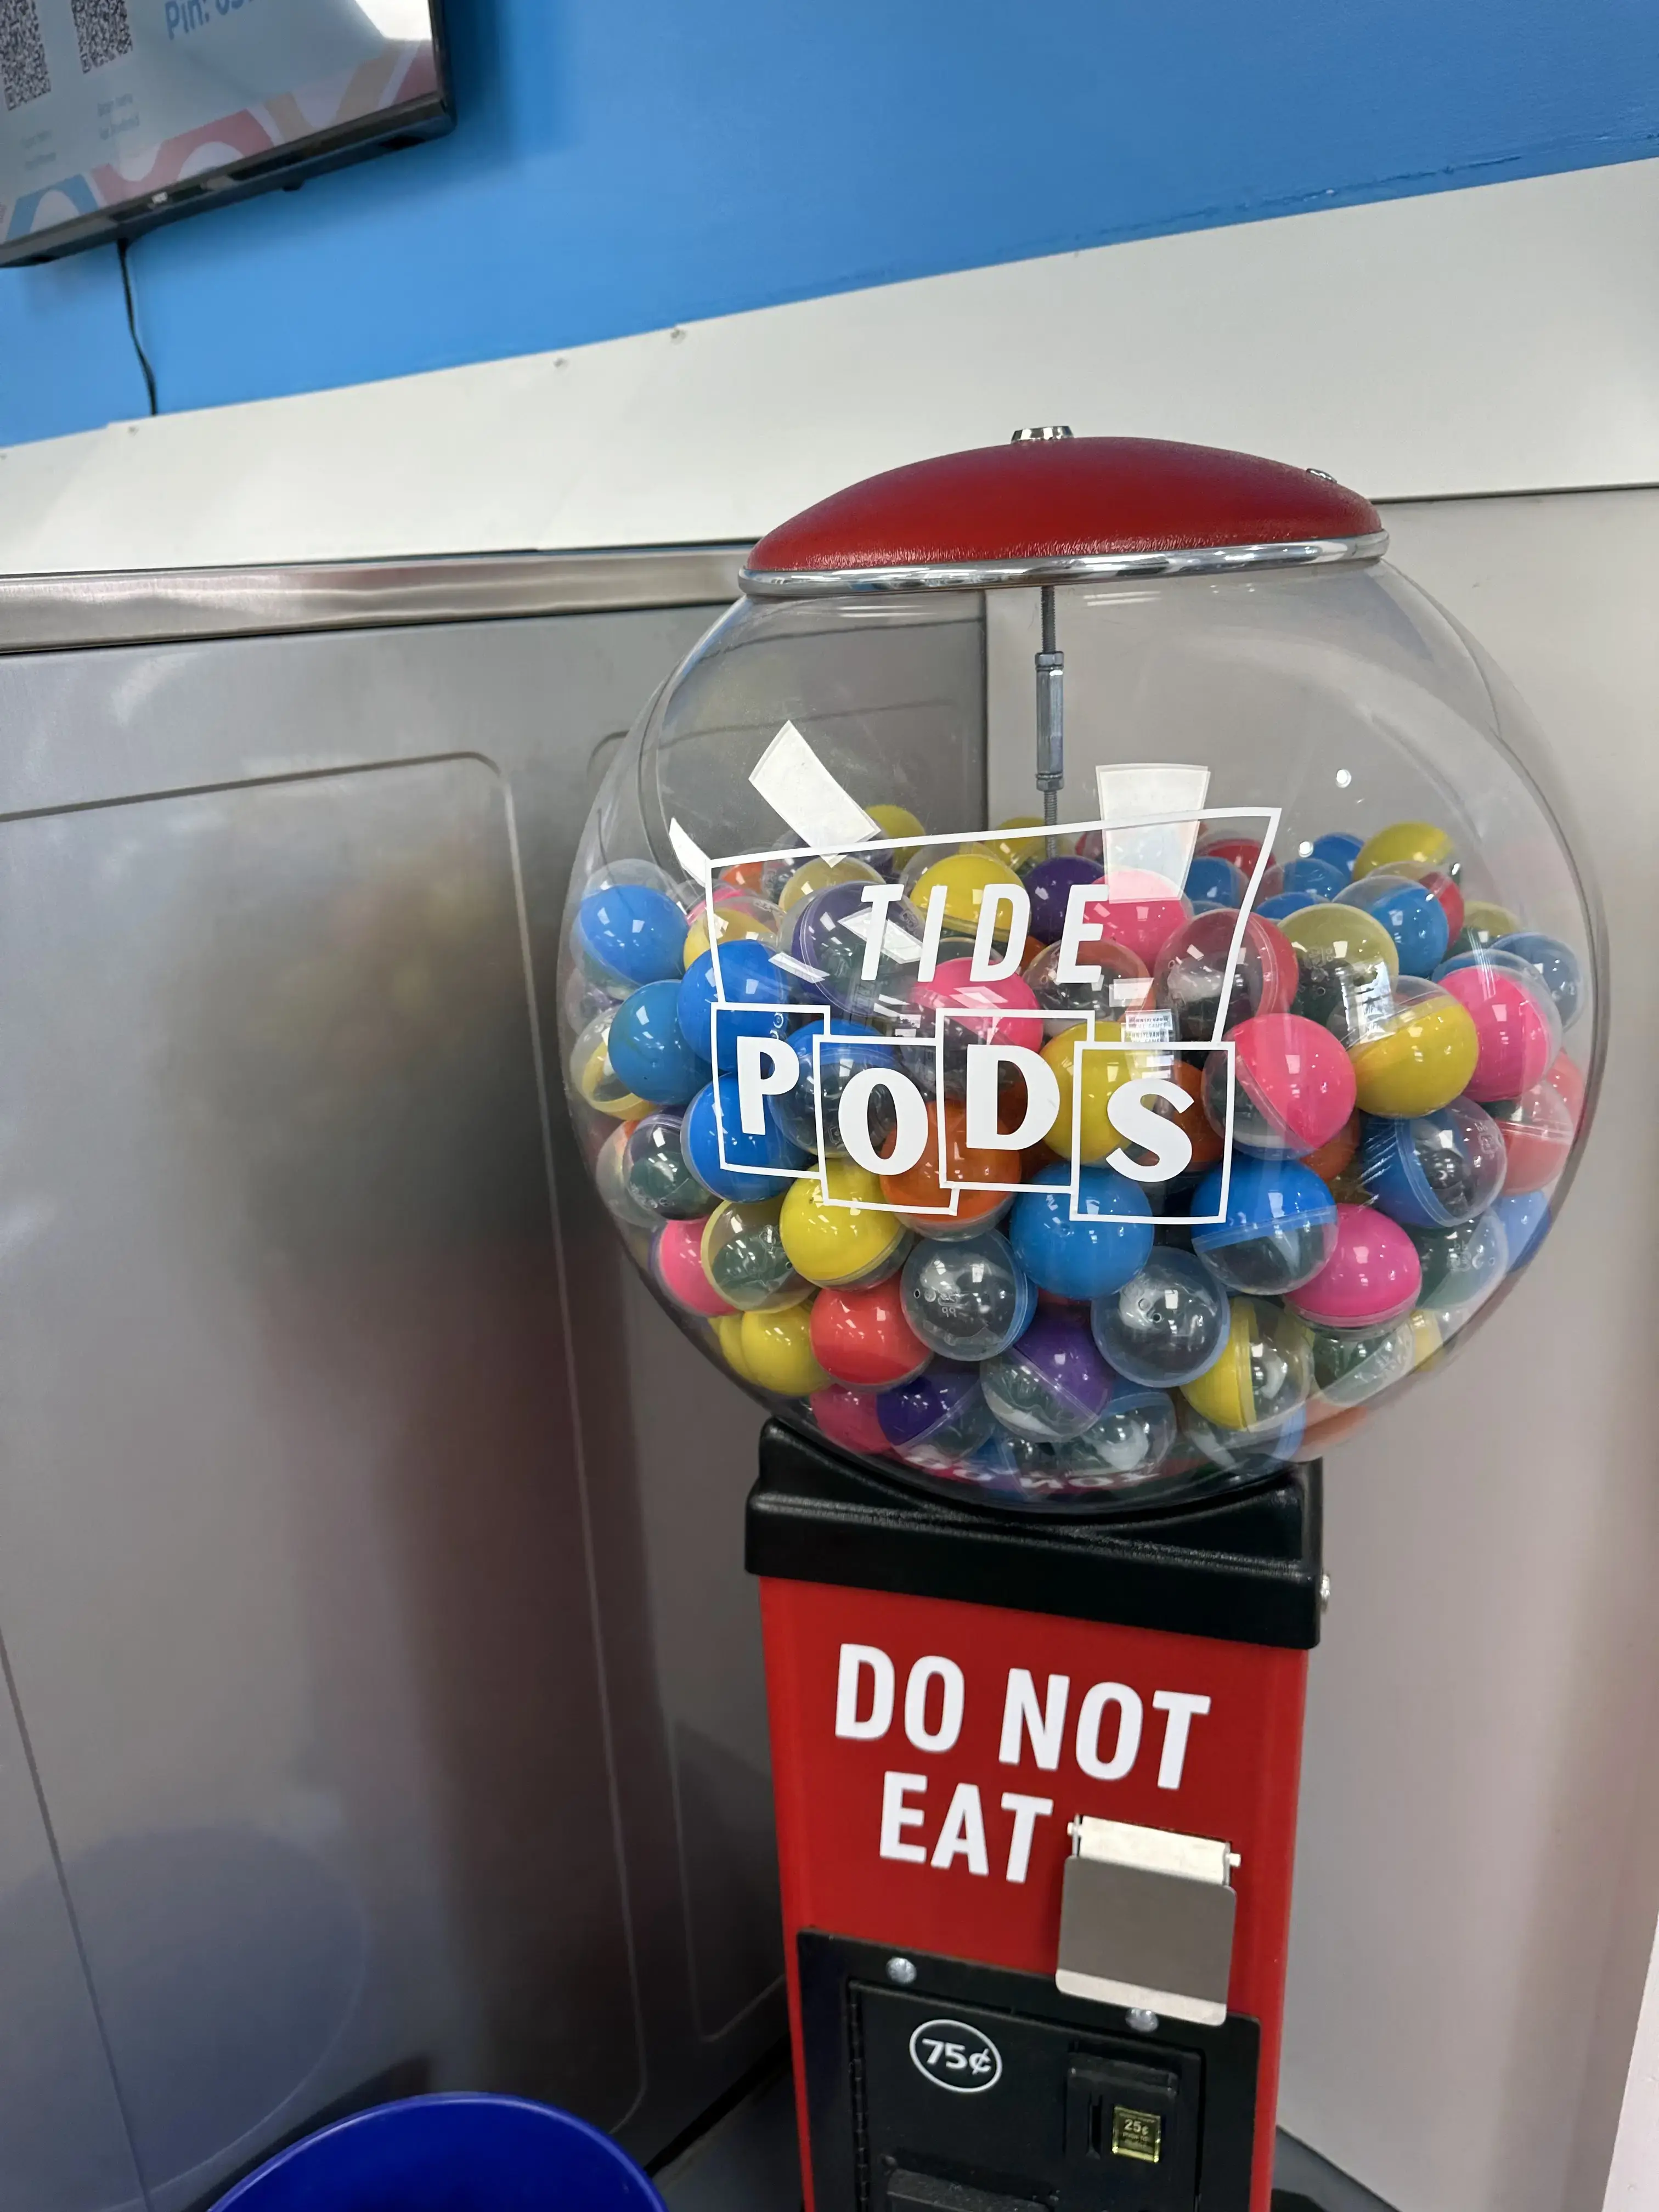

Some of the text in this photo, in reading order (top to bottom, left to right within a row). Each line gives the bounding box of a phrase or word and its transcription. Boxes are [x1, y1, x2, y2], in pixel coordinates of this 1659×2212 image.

[861, 883, 1110, 984] TIDE
[736, 1030, 1195, 1183] PODS
[835, 1643, 1211, 1790] DO NOT
[879, 1771, 1053, 1883] EAT
[922, 2038, 992, 2075] 75¢
